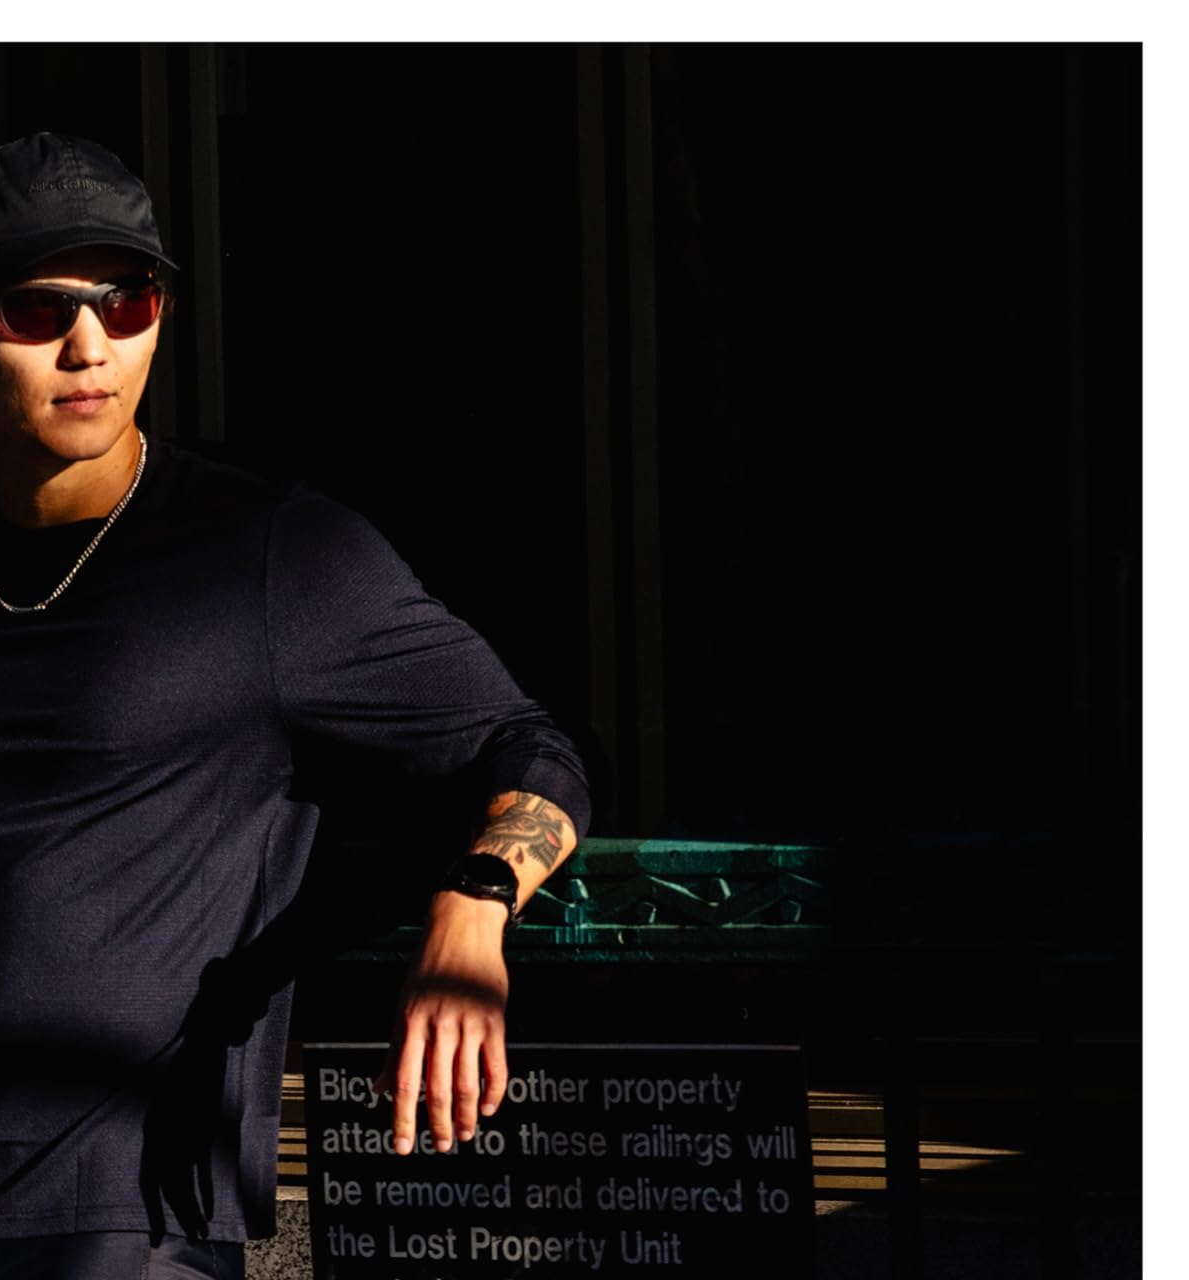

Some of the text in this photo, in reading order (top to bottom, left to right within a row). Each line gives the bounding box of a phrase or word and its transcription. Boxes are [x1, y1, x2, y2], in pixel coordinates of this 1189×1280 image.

[507, 1069, 589, 1104] other
[603, 1072, 743, 1112] property
[473, 1123, 506, 1157] to
[518, 1122, 608, 1158] these
[621, 1122, 734, 1167] railings
[747, 1125, 798, 1161] will
[323, 1171, 791, 1215] be removed and delivered to
[327, 1224, 684, 1270] the Lost Property Unit
